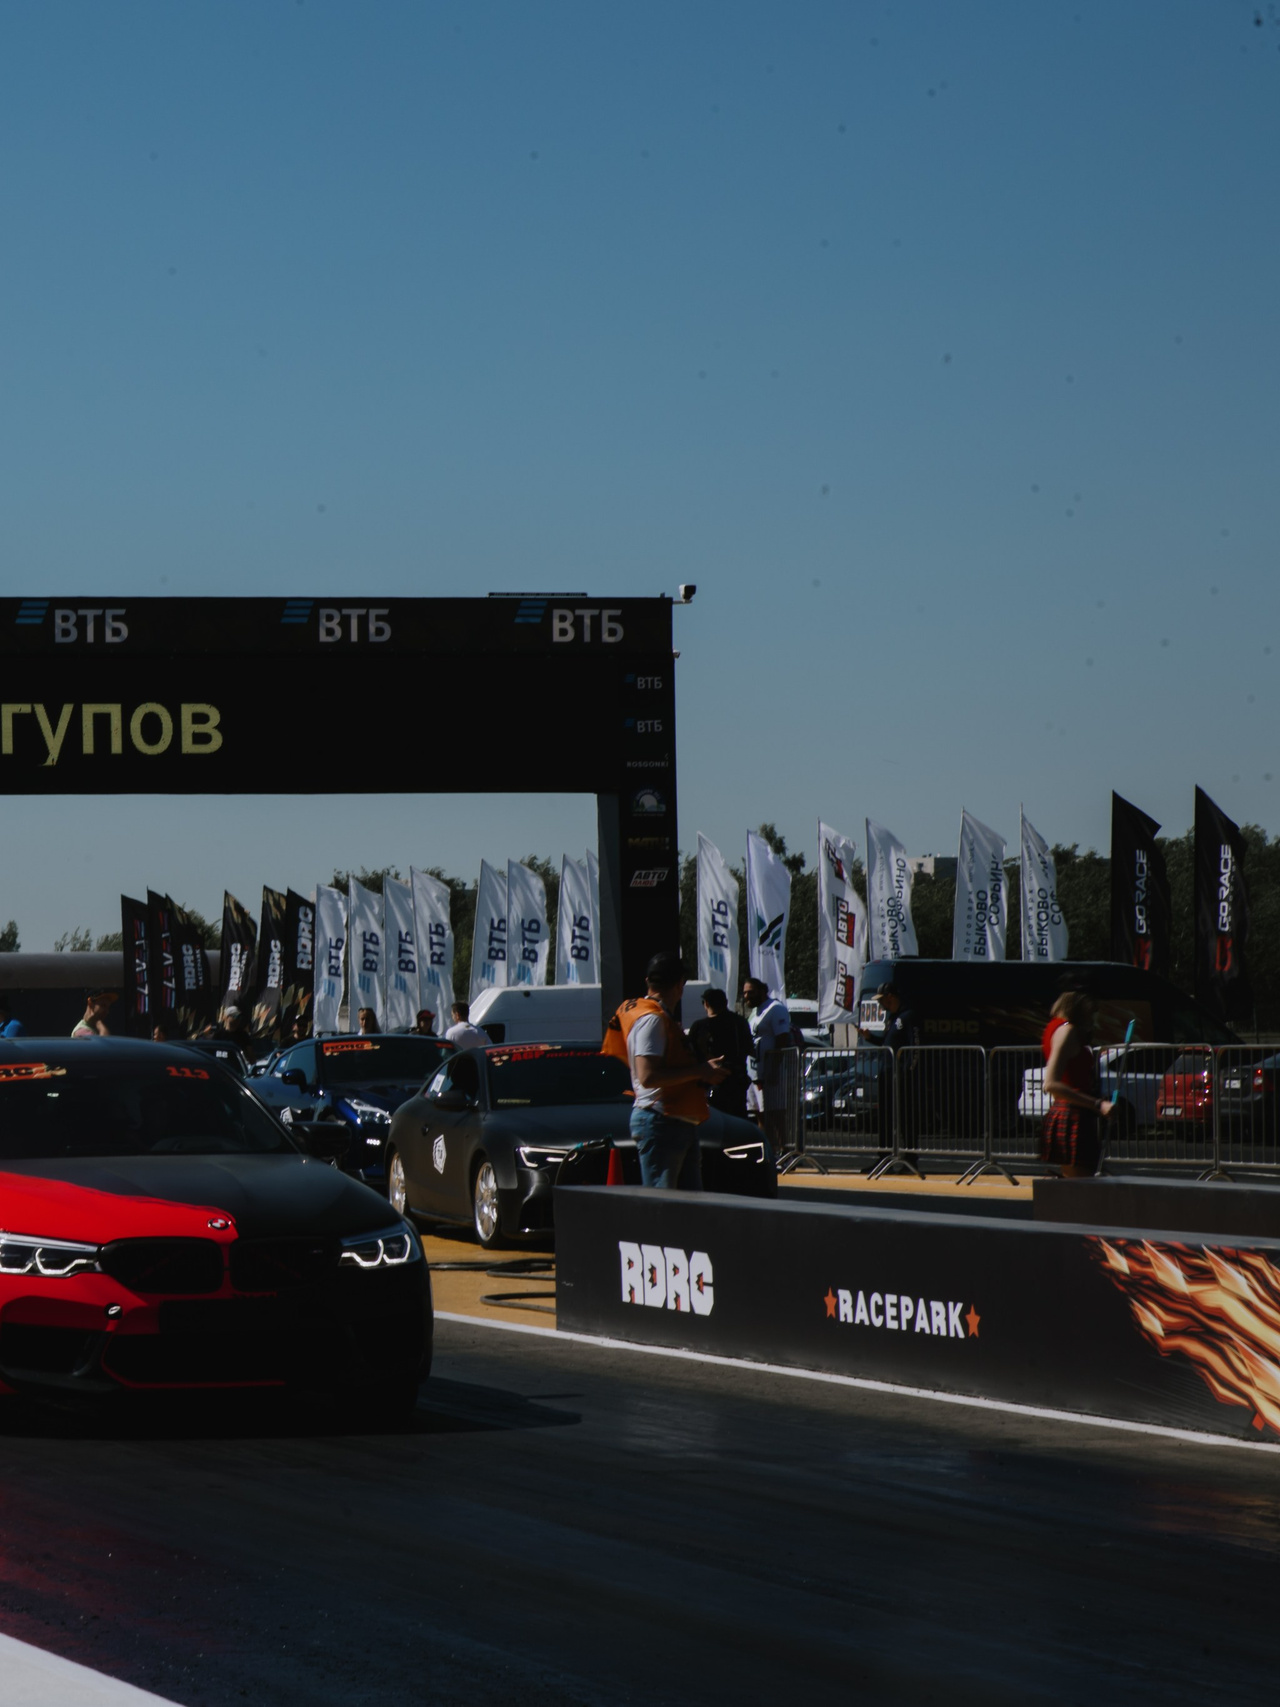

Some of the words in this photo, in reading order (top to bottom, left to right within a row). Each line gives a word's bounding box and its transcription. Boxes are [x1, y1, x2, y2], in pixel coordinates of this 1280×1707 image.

[54, 608, 129, 643] ВТБ
[318, 608, 392, 643] ВТБ
[551, 608, 624, 643] ВТБ
[636, 676, 663, 689] ВТБ
[636, 720, 663, 733] ВТБ
[297, 905, 313, 970] RDRC
[488, 917, 507, 961] ВТБ
[521, 918, 541, 963] ВТБ
[571, 914, 590, 962] ВТБ
[973, 889, 988, 957] БЫКОВО
[1036, 887, 1050, 958] БЫКОВО
[181, 944, 197, 990] RDRC
[228, 942, 241, 990] RDRC
[267, 939, 281, 988] RDRC
[362, 930, 380, 973] ВТБ
[397, 930, 417, 974] ВТБ
[924, 1019, 981, 1034] RDRC
[619, 1240, 714, 1316] RDRC
[837, 1288, 965, 1339] RACEPARK
